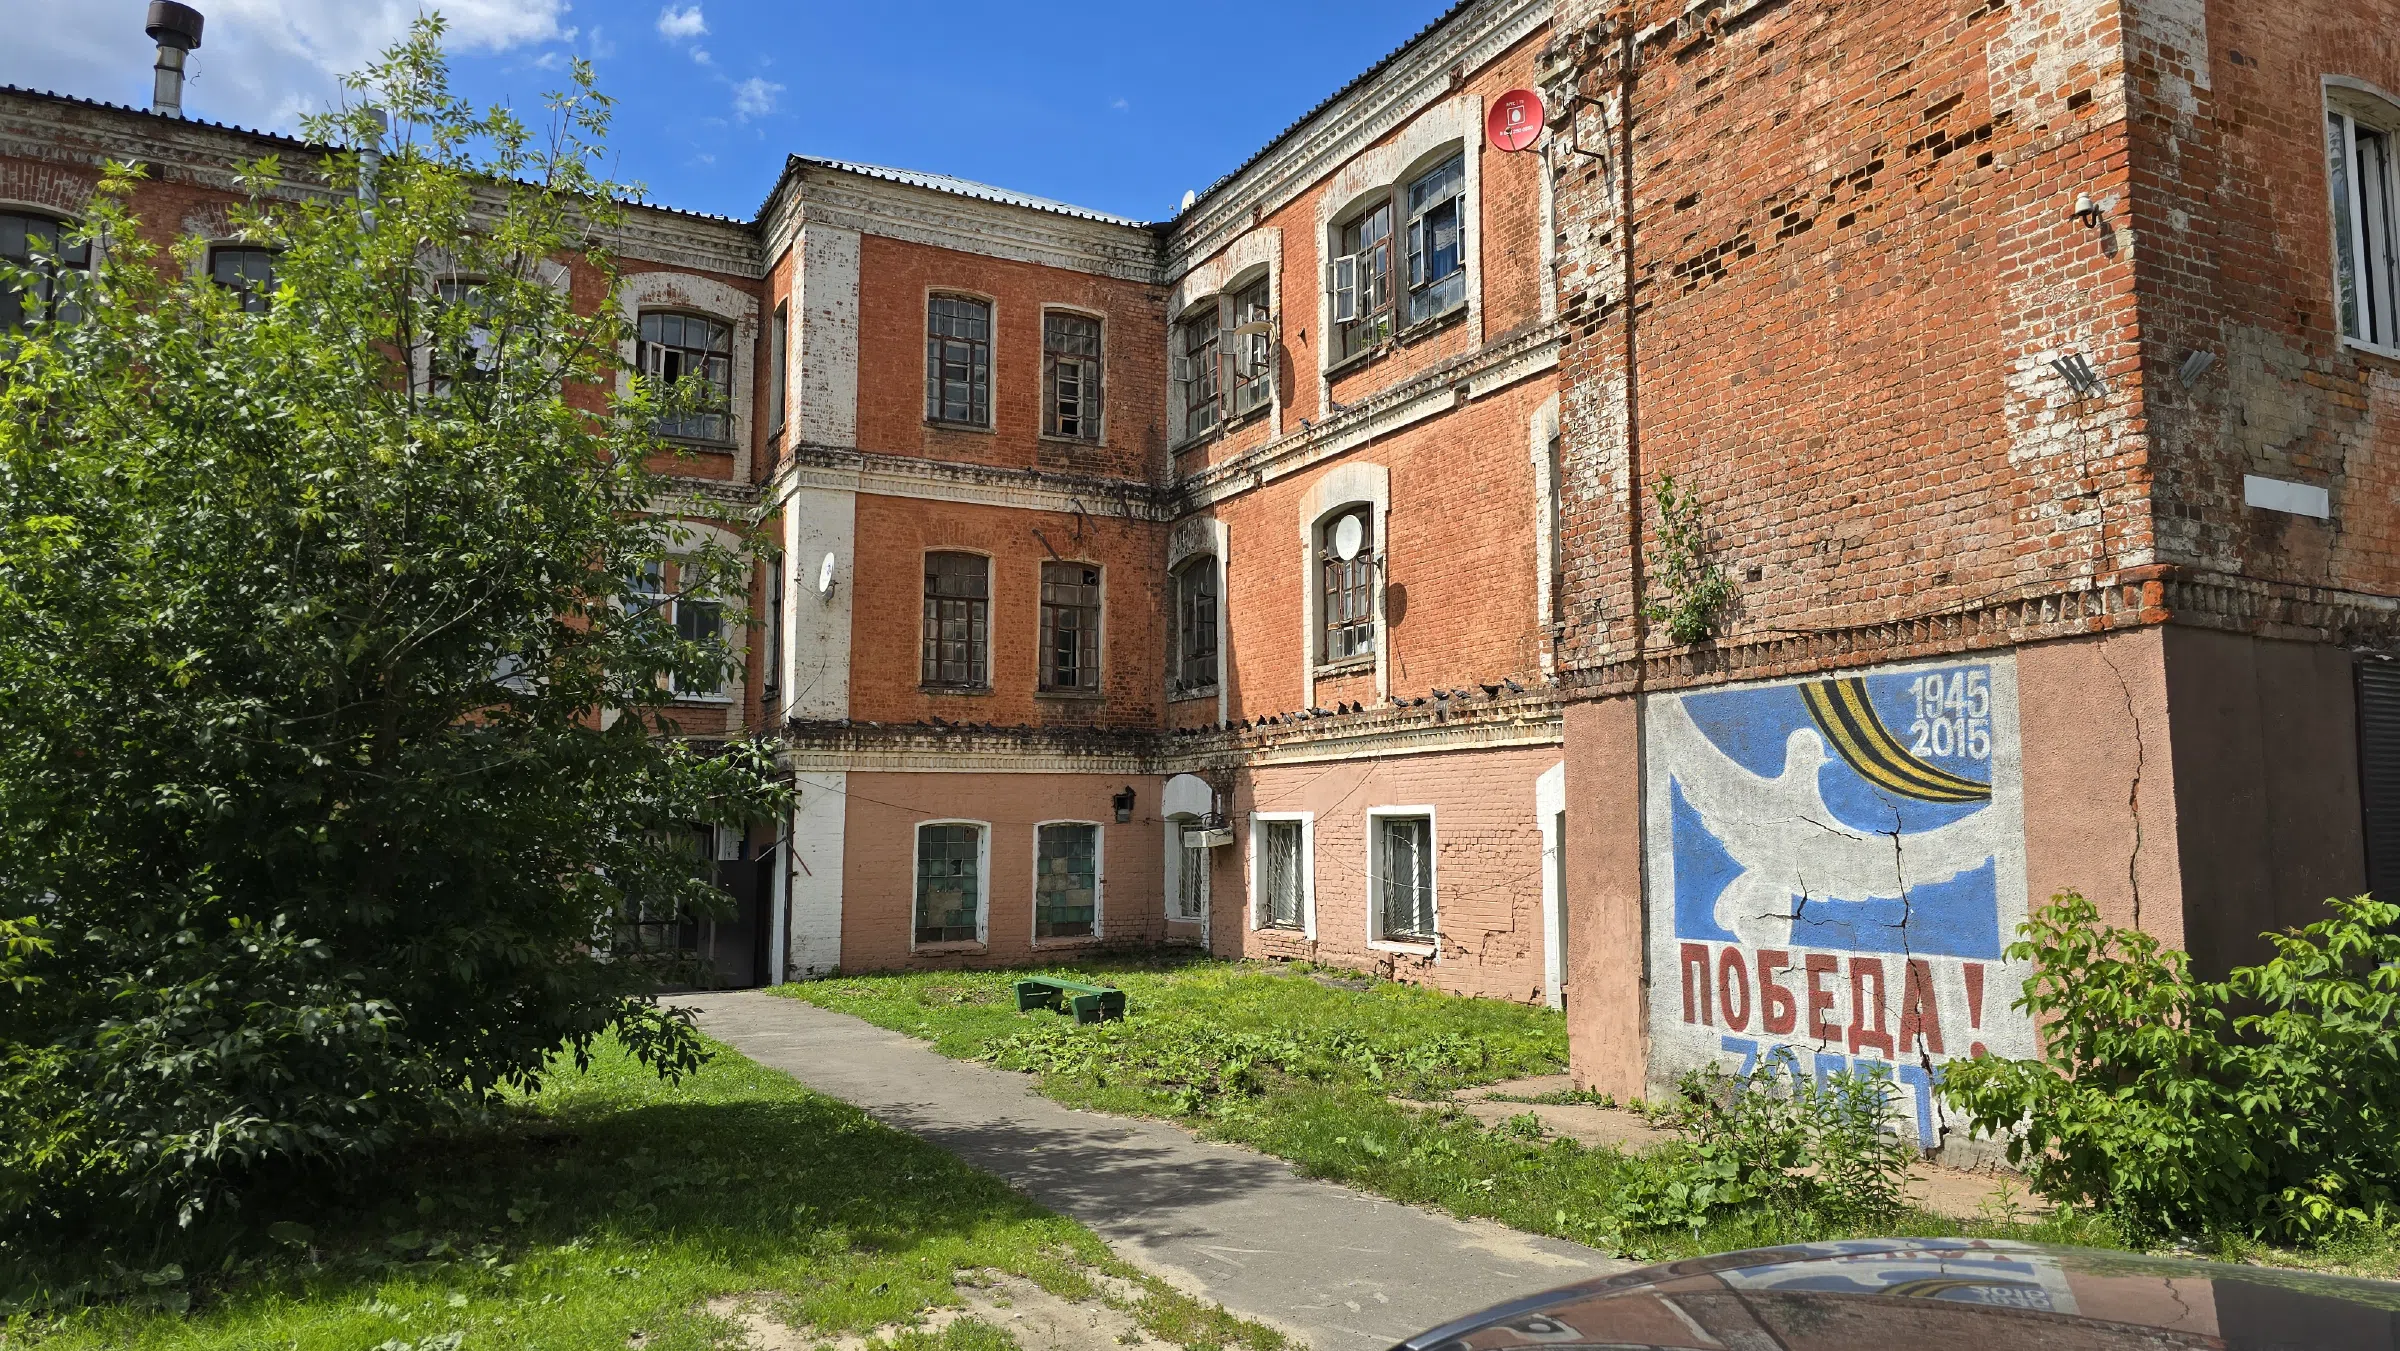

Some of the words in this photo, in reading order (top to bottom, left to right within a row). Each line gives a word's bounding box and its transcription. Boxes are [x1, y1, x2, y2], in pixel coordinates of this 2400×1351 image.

[1908, 670, 1989, 718] 1945
[1910, 717, 1990, 760] 2015
[1681, 943, 1987, 1060] ПОБЕДА!
